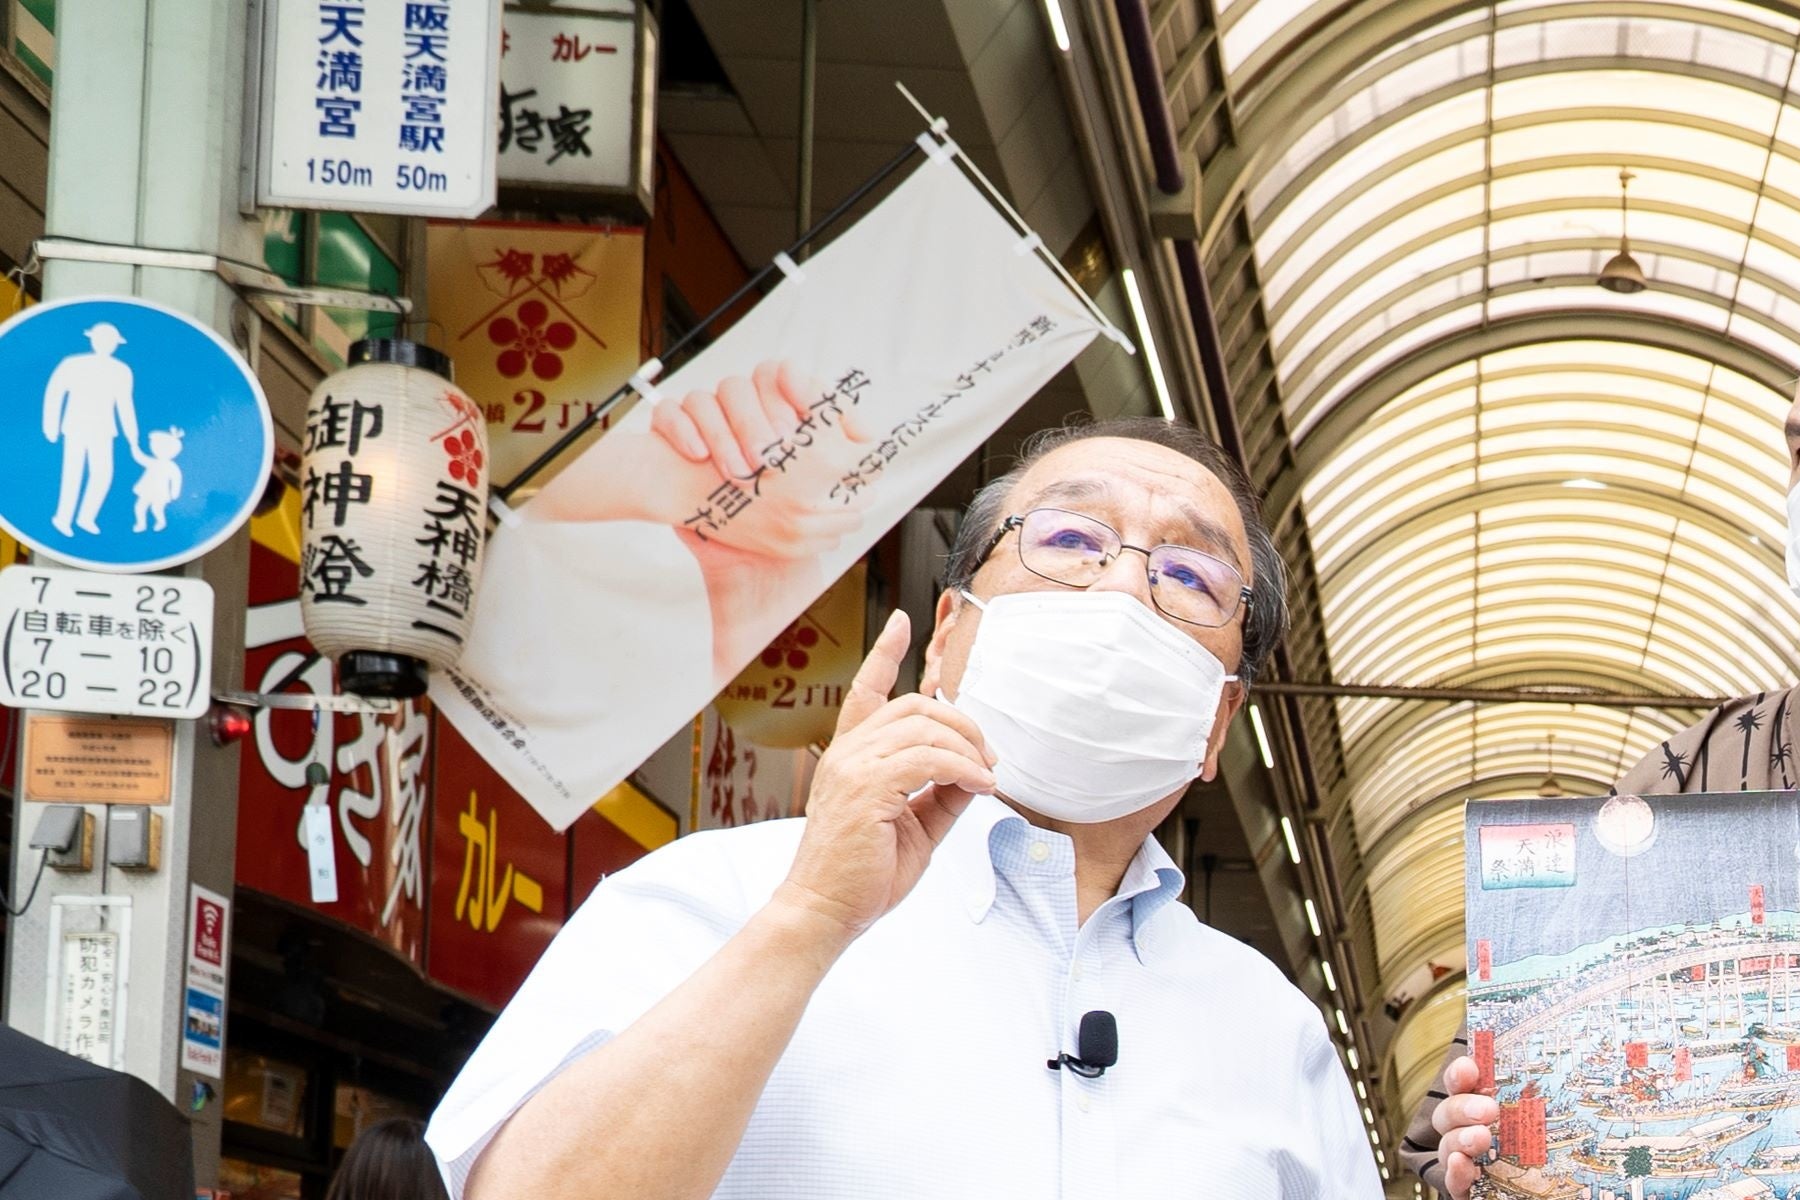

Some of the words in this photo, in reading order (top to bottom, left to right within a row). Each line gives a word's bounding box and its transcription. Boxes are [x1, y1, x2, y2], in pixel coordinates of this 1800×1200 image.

[551, 32, 618, 63] カレー
[316, 0, 366, 140] 天満宮
[397, 0, 451, 154] 阪天満宮駅
[306, 158, 373, 188] 150m
[395, 165, 449, 192] 50m
[684, 368, 872, 542] 私たちは人間だ
[411, 481, 481, 646] 天神橋二
[31, 576, 52, 604] 7
[135, 585, 182, 615] 22
[34, 638, 54, 666] 7
[140, 646, 174, 674] 10
[21, 669, 66, 700] 20
[138, 678, 182, 708] 22
[456, 789, 543, 934] カレー
